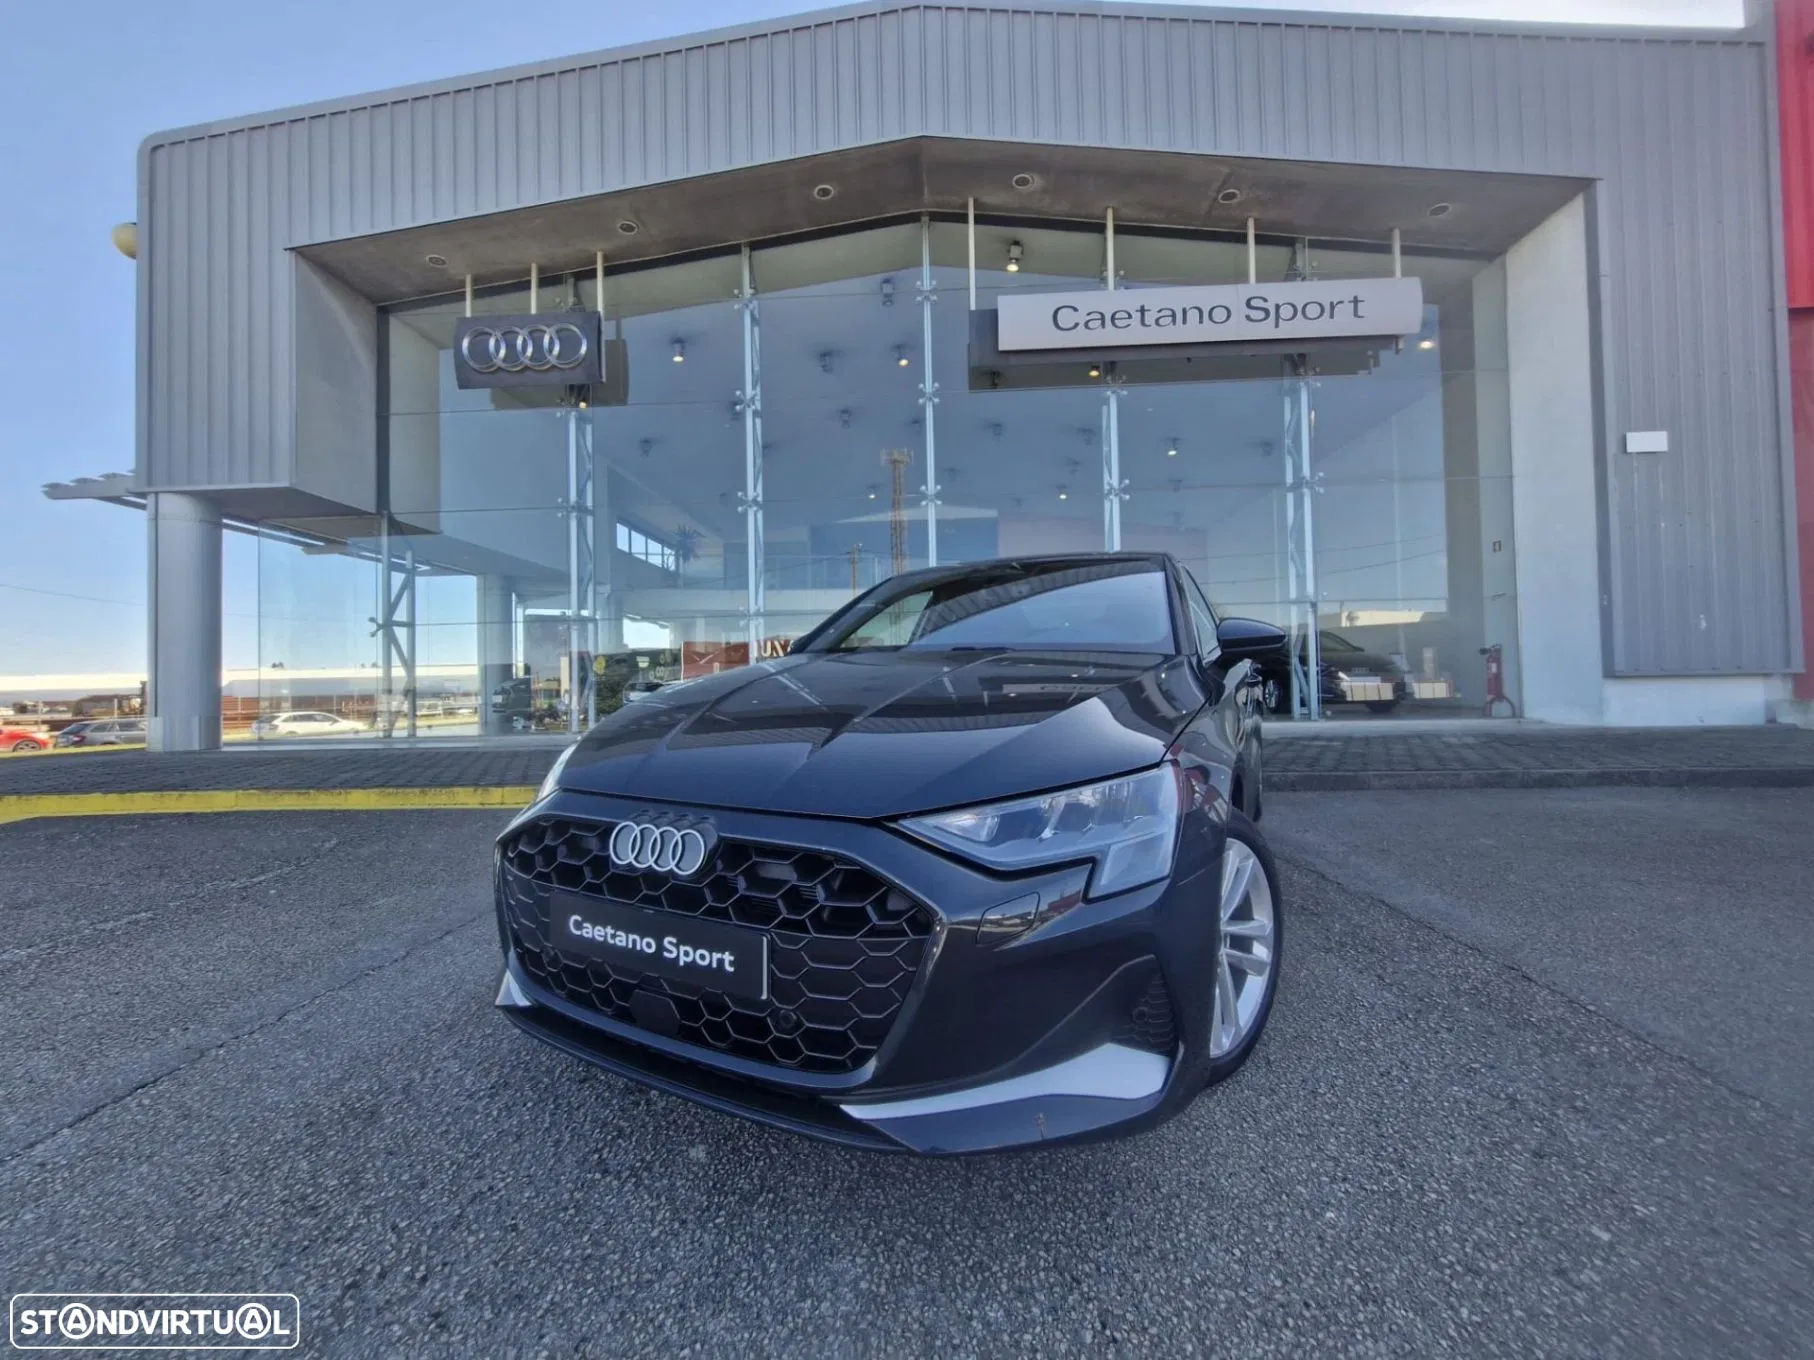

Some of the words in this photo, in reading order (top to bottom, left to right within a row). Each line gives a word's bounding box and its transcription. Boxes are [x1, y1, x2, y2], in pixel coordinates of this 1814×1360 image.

[1052, 304, 1232, 331] Caetano
[1244, 295, 1366, 328] Sport
[568, 914, 656, 953] Caetano
[662, 936, 735, 972] Sport
